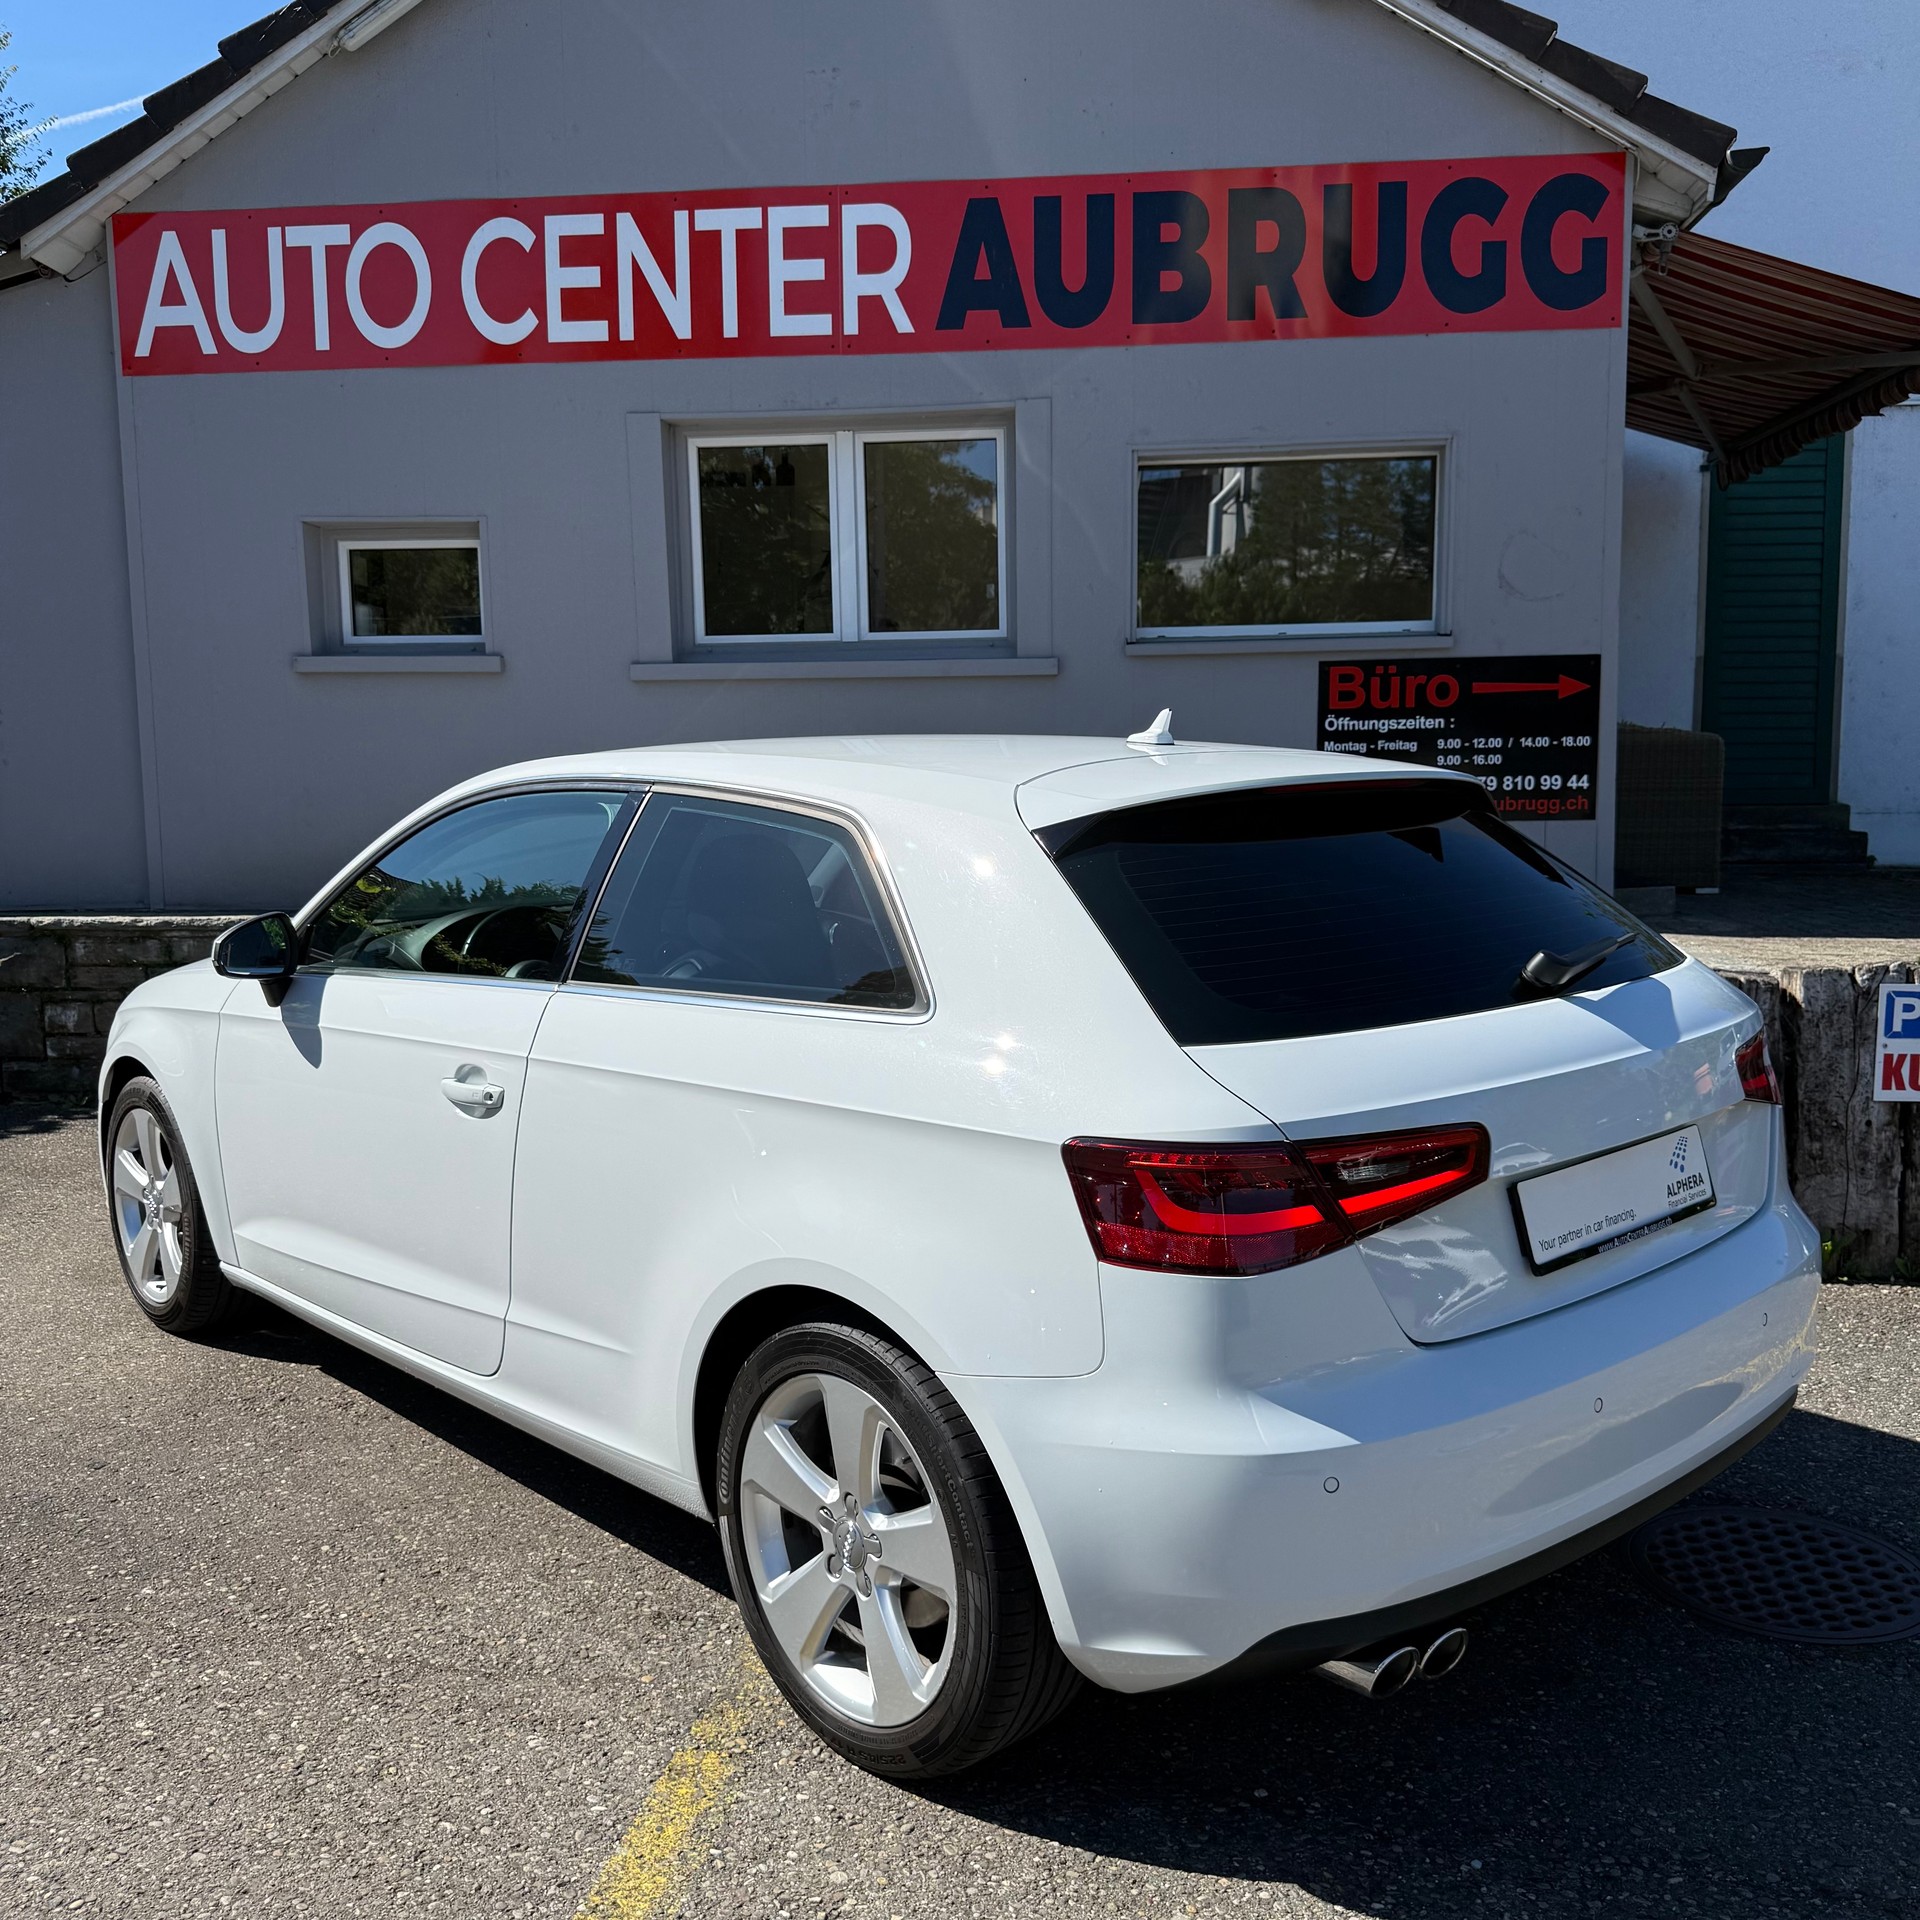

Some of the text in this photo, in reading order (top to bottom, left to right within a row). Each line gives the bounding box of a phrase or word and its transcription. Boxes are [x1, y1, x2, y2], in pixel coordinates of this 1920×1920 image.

[134, 172, 1610, 358] AUTO CENTER AUBRUGG
[1328, 665, 1460, 709] Büro
[1324, 714, 1445, 733] Öffnungszeiten
[1324, 741, 1367, 753] Montag
[1377, 740, 1418, 752] Freitag
[1436, 738, 1462, 749] 9.00
[1472, 737, 1503, 749] 12.00
[1519, 736, 1550, 748] 14.00
[1560, 735, 1591, 747] 18.00
[1436, 754, 1462, 766] 9.00
[1472, 754, 1503, 765] 16.00
[1502, 775, 1535, 790] 810
[1540, 775, 1562, 790] 99
[1566, 774, 1590, 789] 44
[1893, 997, 1920, 1032] P
[1666, 1171, 1705, 1199] ALPHERA
[1538, 1208, 1637, 1252] Your partner in car financing.
